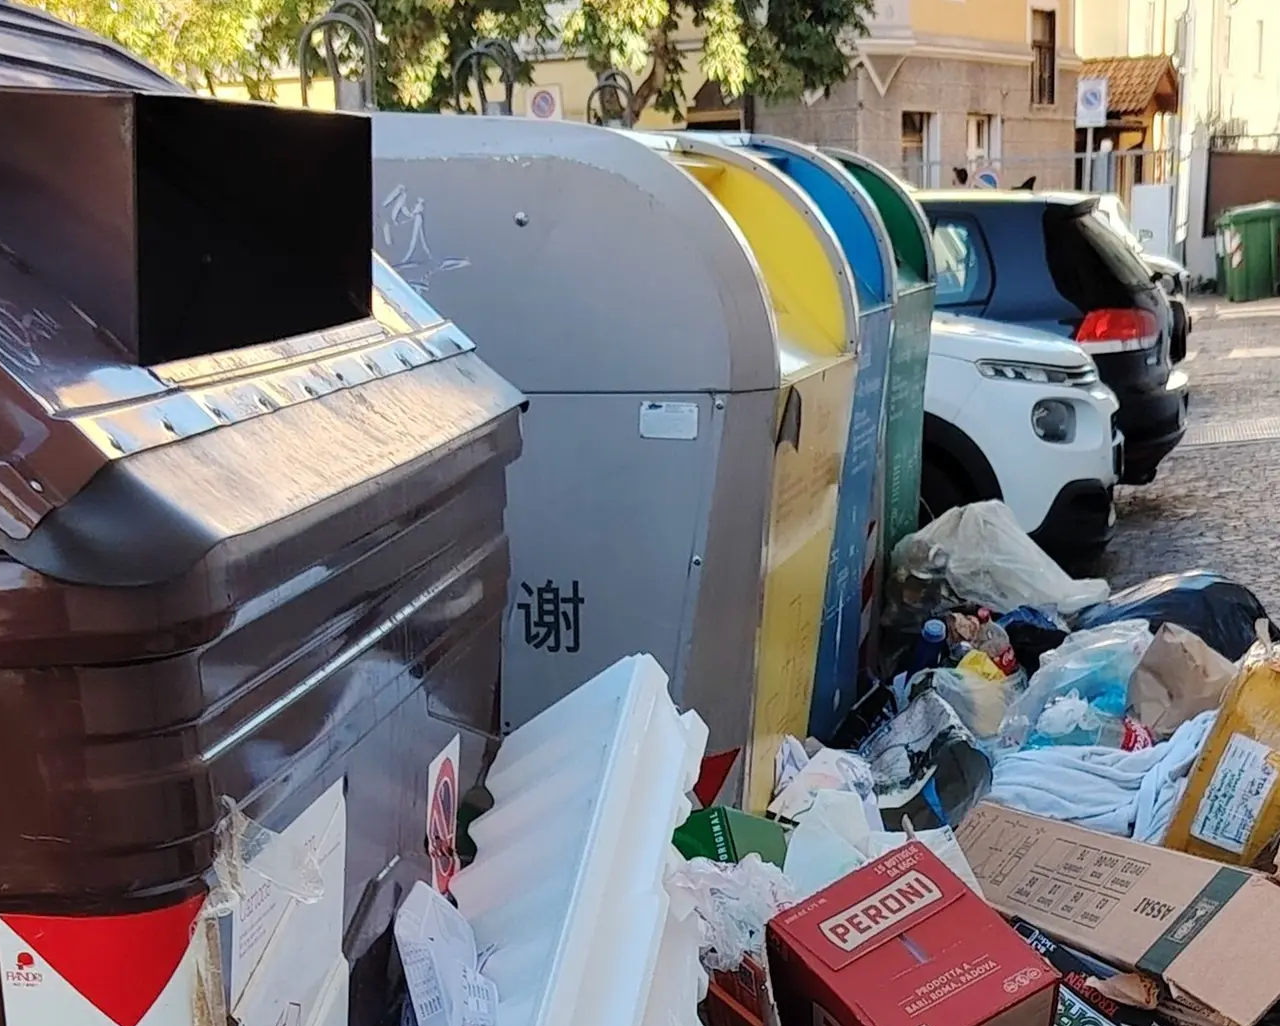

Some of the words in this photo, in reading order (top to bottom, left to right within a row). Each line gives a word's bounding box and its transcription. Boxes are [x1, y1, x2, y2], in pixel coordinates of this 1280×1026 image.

[517, 578, 585, 653] 谢
[709, 809, 730, 862] ORIGINAL
[829, 876, 934, 945] PERONI
[1133, 896, 1177, 922] ASSAI
[915, 966, 963, 996] PRODOTTA
[959, 960, 998, 985] PADOVA
